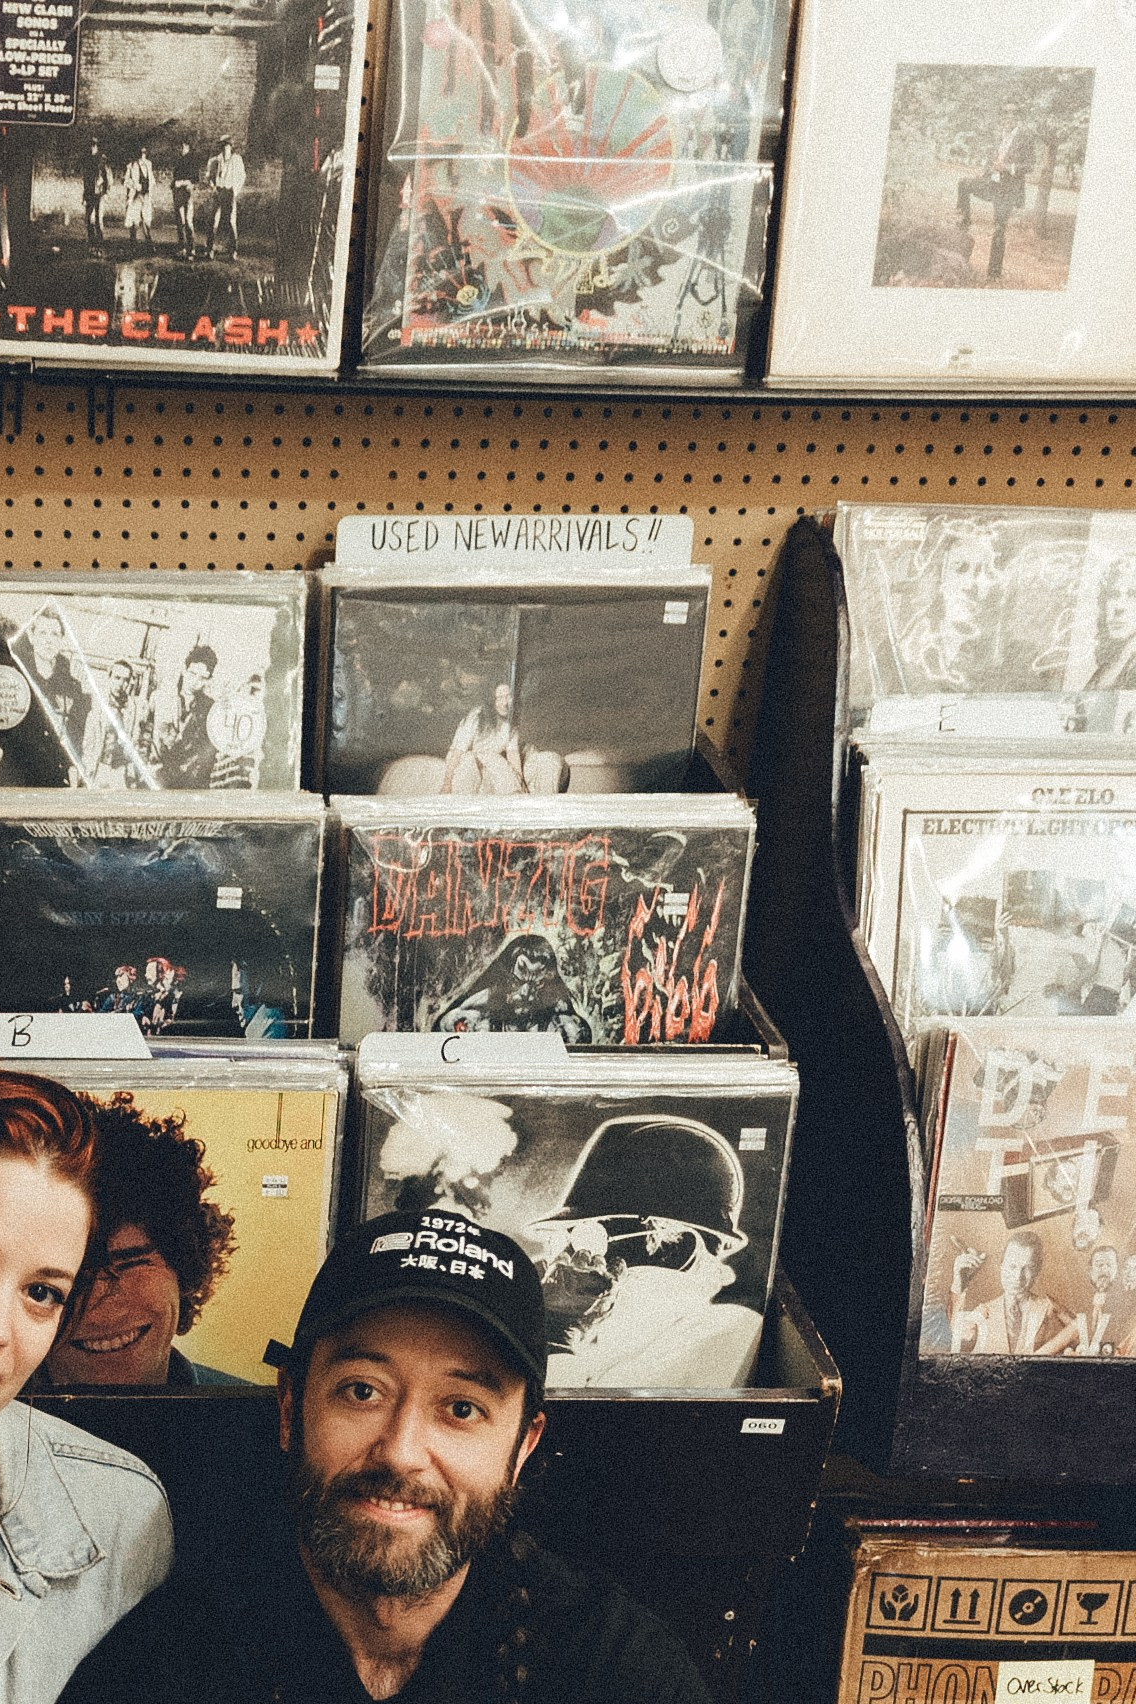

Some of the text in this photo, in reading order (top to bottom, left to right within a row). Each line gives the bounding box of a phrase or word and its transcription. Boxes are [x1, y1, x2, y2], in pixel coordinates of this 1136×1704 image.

[16, 16, 58, 30] SONGS
[33, 4, 74, 17] CLASH
[120, 311, 290, 346] CLASH
[371, 520, 439, 553] USED
[10, 1014, 32, 1048] B
[440, 1035, 461, 1064] C
[246, 1137, 298, 1153] goodbye
[400, 1253, 486, 1280] 大阪、日本
[414, 1230, 514, 1280] Roland
